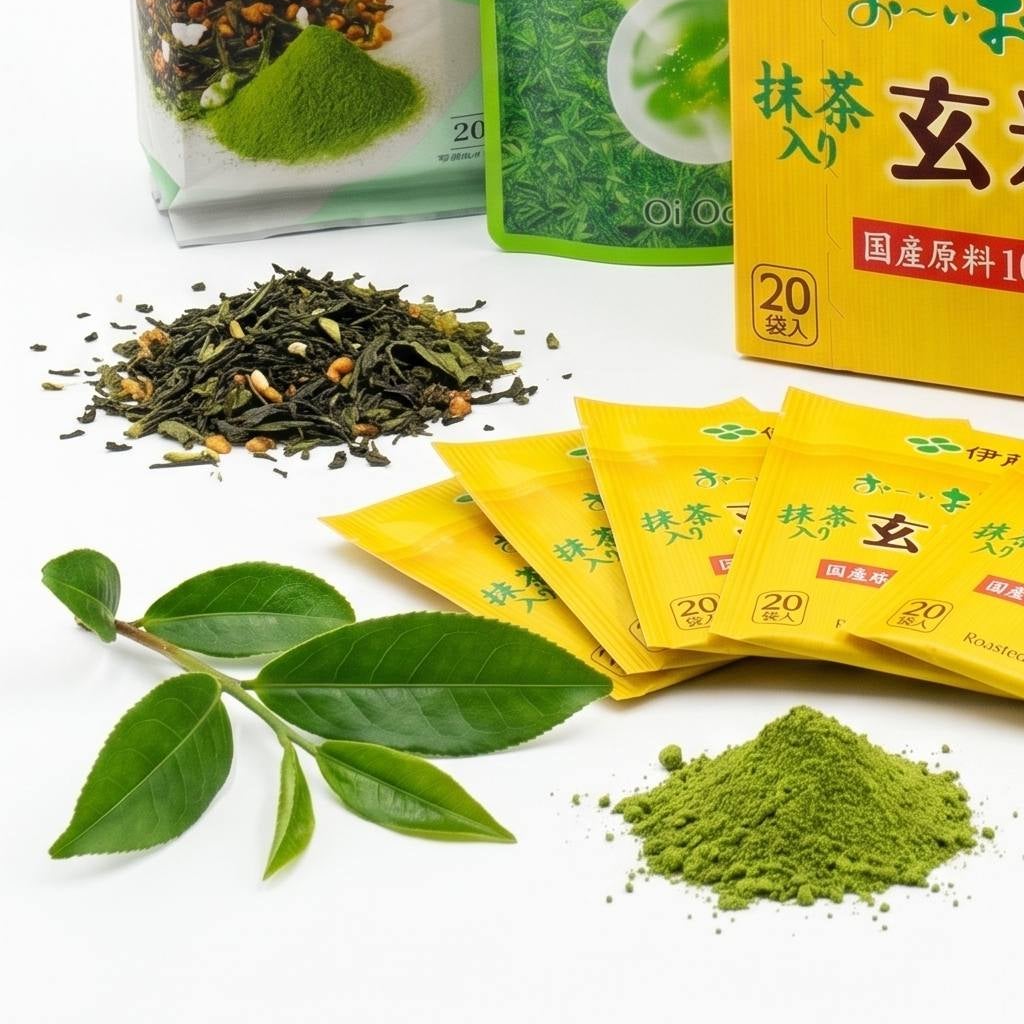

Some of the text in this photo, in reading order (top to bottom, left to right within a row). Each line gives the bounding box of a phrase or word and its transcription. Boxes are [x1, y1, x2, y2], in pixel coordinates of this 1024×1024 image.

[753, 60, 875, 134] 抹茶
[777, 126, 838, 170] 入り
[644, 199, 680, 226] Oi
[759, 272, 812, 315] 20
[765, 314, 808, 339] 袋入
[641, 503, 722, 533] 抹茶
[778, 504, 857, 528] 抹茶
[788, 525, 831, 542] 入り
[863, 513, 929, 554] 玄
[678, 596, 718, 617] 20
[761, 593, 803, 612] 20
[902, 601, 946, 619] 20
